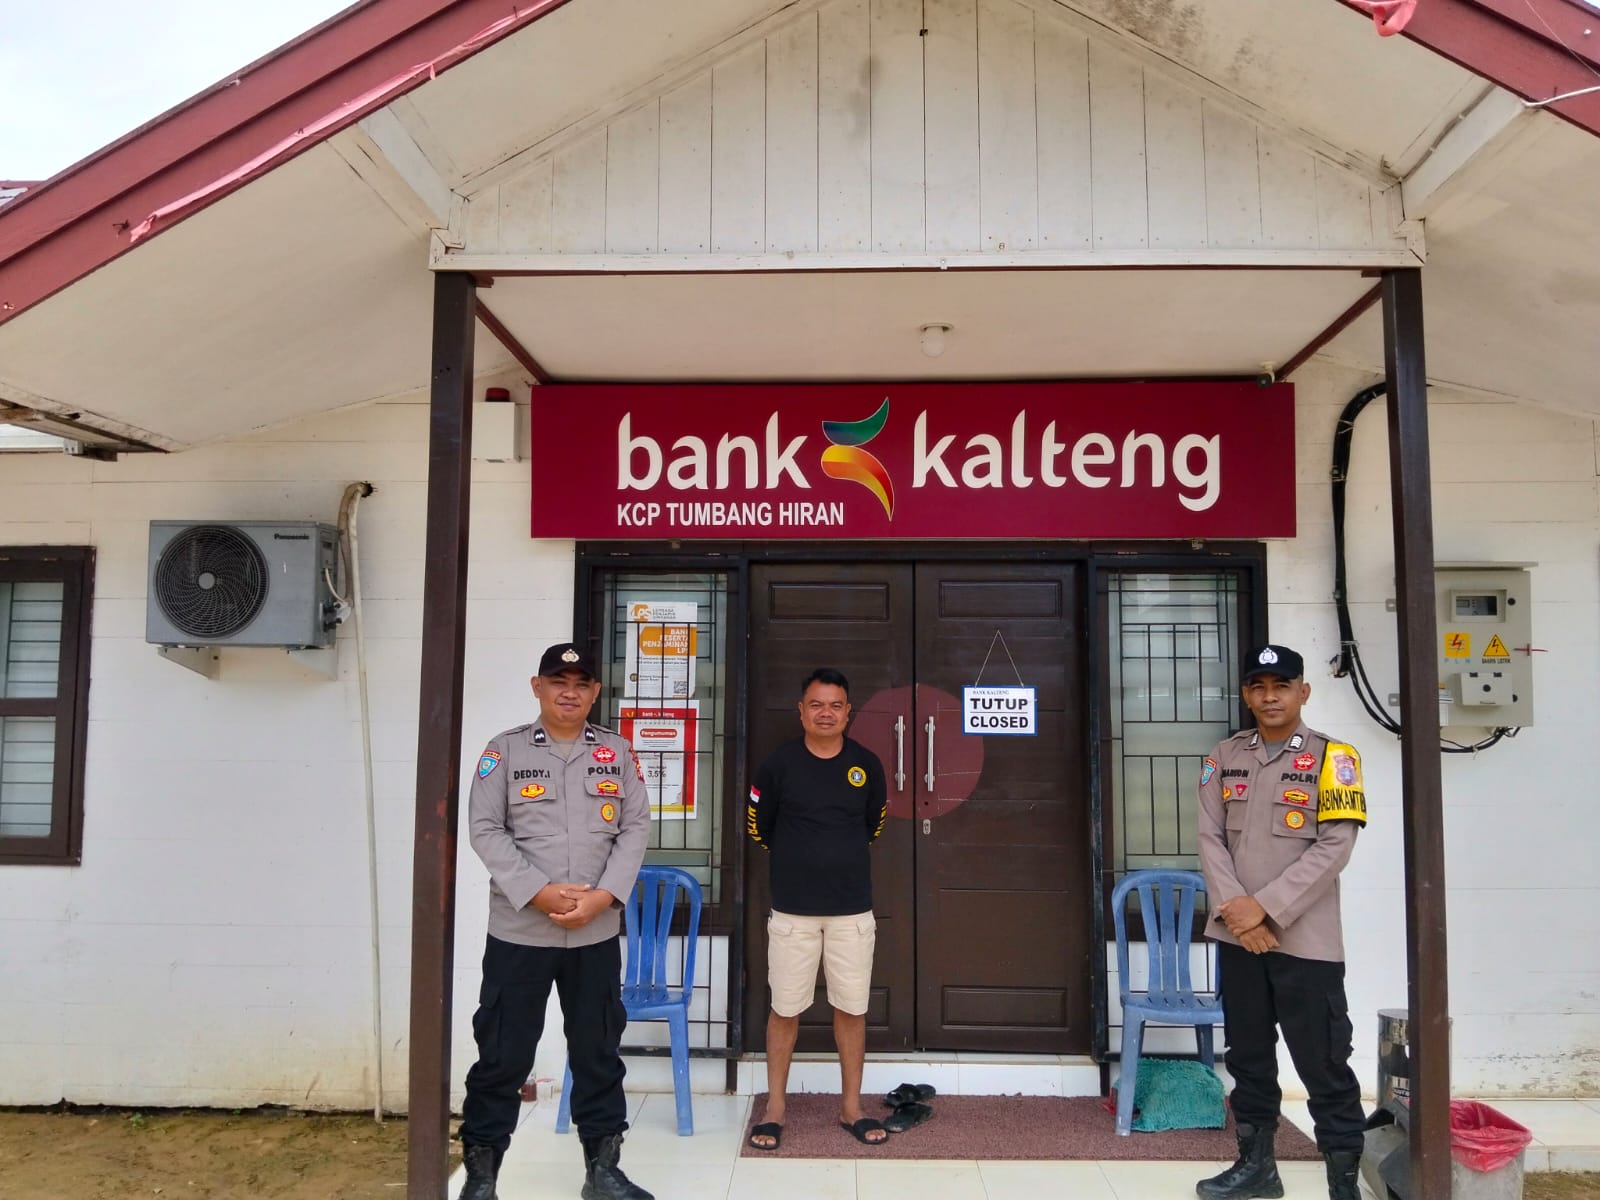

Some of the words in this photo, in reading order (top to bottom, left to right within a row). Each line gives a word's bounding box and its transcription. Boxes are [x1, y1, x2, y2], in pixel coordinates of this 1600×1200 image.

[618, 412, 811, 490] bank
[912, 410, 1220, 511] kalteng
[618, 503, 661, 525] KCP
[666, 503, 773, 525] TUMBANG
[779, 503, 843, 525] HIRAN
[970, 698, 1028, 710] TUTUP
[970, 715, 1028, 728] CLOSED
[588, 766, 621, 776] POLRI
[1281, 772, 1318, 785] POLRI
